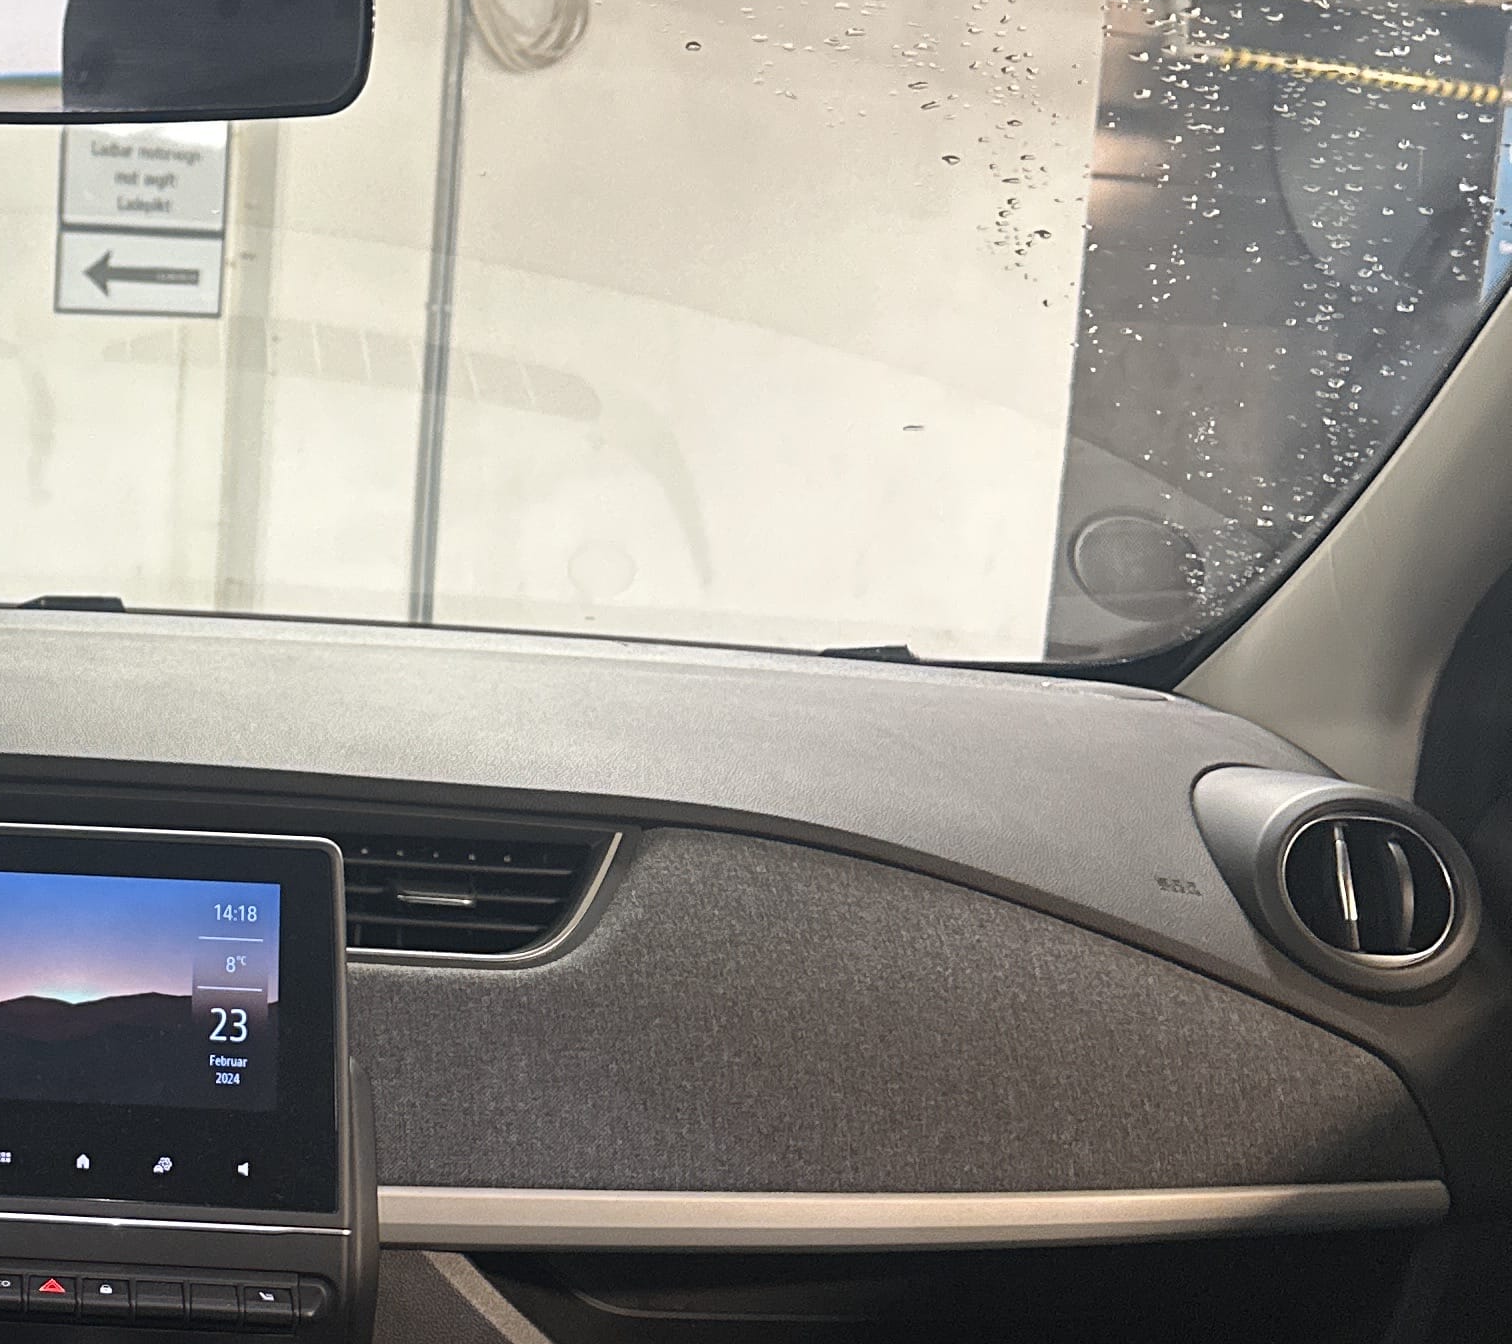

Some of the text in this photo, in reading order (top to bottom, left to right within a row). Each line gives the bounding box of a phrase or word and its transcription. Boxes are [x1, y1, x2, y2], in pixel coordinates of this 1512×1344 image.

[214, 904, 257, 922] 14:18
[209, 1008, 248, 1042] 23
[209, 1055, 248, 1068] Februar
[215, 1072, 241, 1085] 2024
